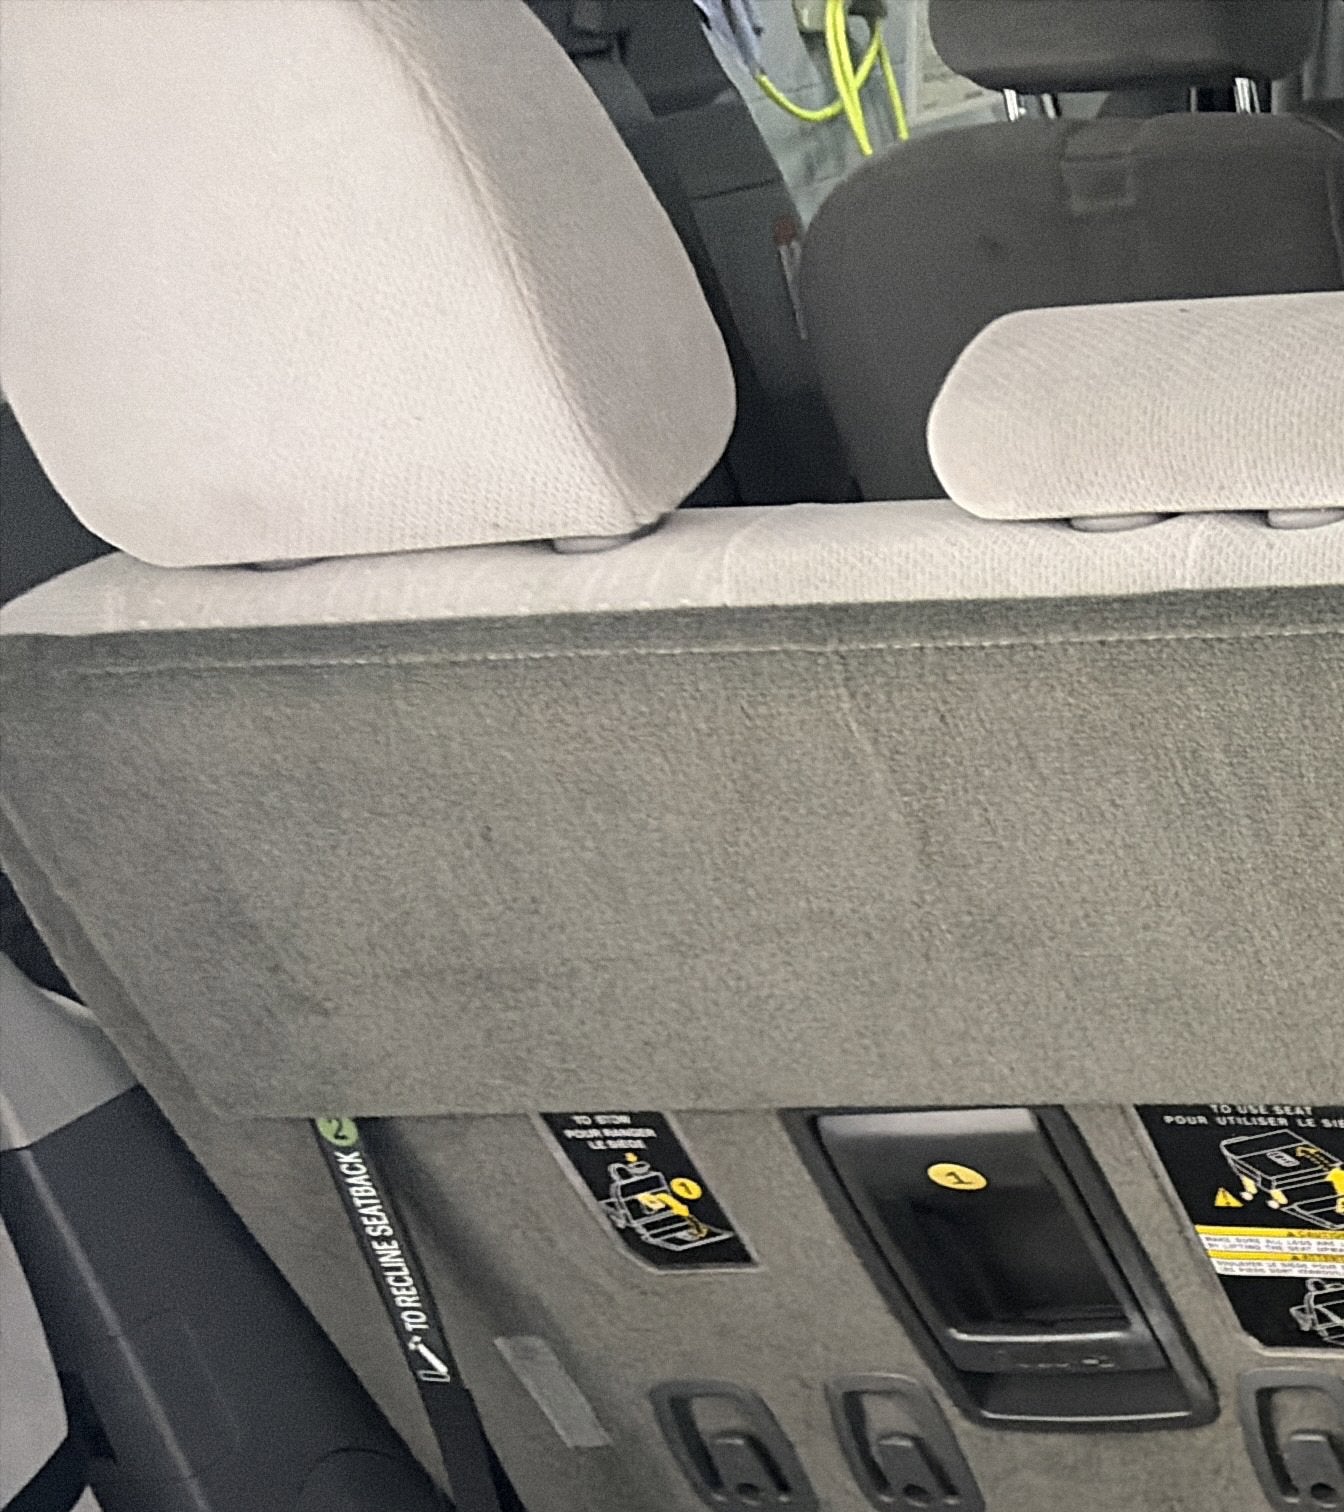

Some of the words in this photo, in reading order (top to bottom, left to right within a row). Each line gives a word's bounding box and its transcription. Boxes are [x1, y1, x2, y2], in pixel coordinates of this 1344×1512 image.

[1210, 1104, 1231, 1114] TO
[1236, 1104, 1269, 1115] USE
[1271, 1105, 1313, 1116] SEAT
[1163, 1115, 1208, 1125] POUR
[1215, 1116, 1289, 1127] UTILISER
[1297, 1117, 1317, 1128] LE
[334, 1150, 394, 1237] SEATBACK
[370, 1239, 423, 1308] RECLINE
[400, 1310, 429, 1332] TO
